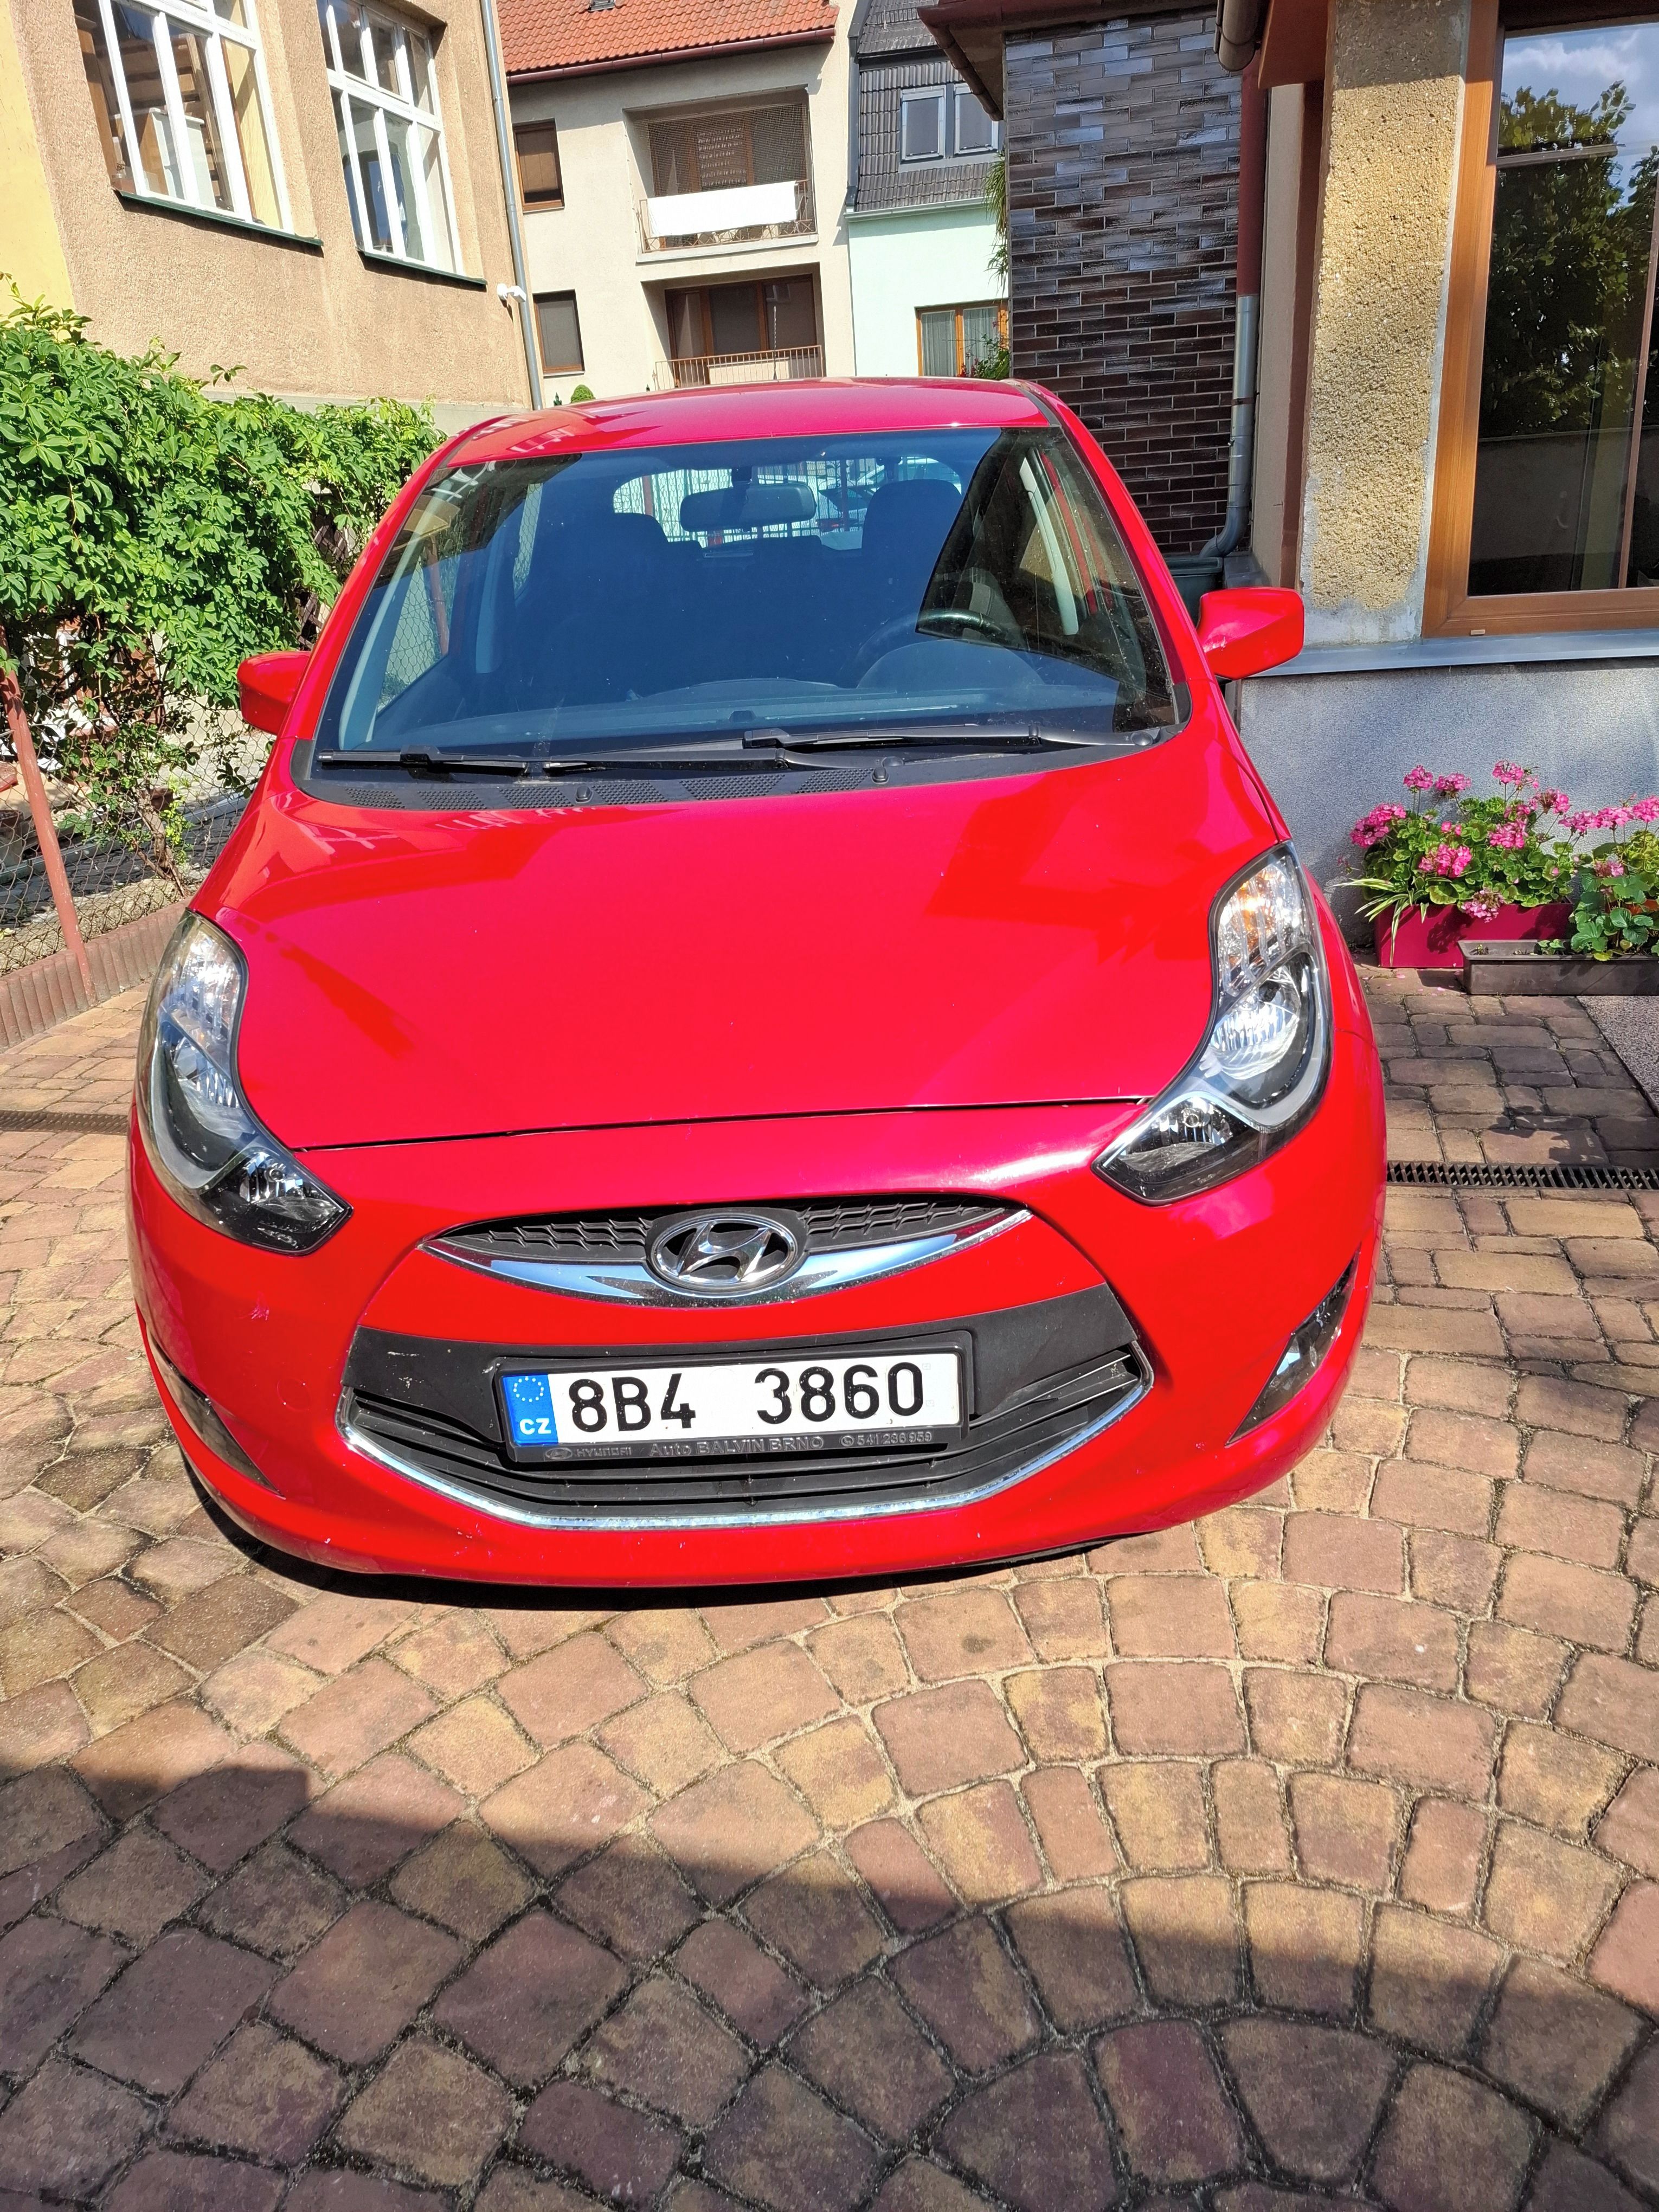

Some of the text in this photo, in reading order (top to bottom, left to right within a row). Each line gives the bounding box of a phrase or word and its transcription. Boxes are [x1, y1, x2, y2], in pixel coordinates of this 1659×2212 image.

[569, 1361, 924, 1432] 8B4 3860
[519, 1418, 551, 1435] CZ
[650, 1443, 692, 1457] Auto
[696, 1438, 765, 1455] BALVIN
[769, 1435, 825, 1452] BRNO
